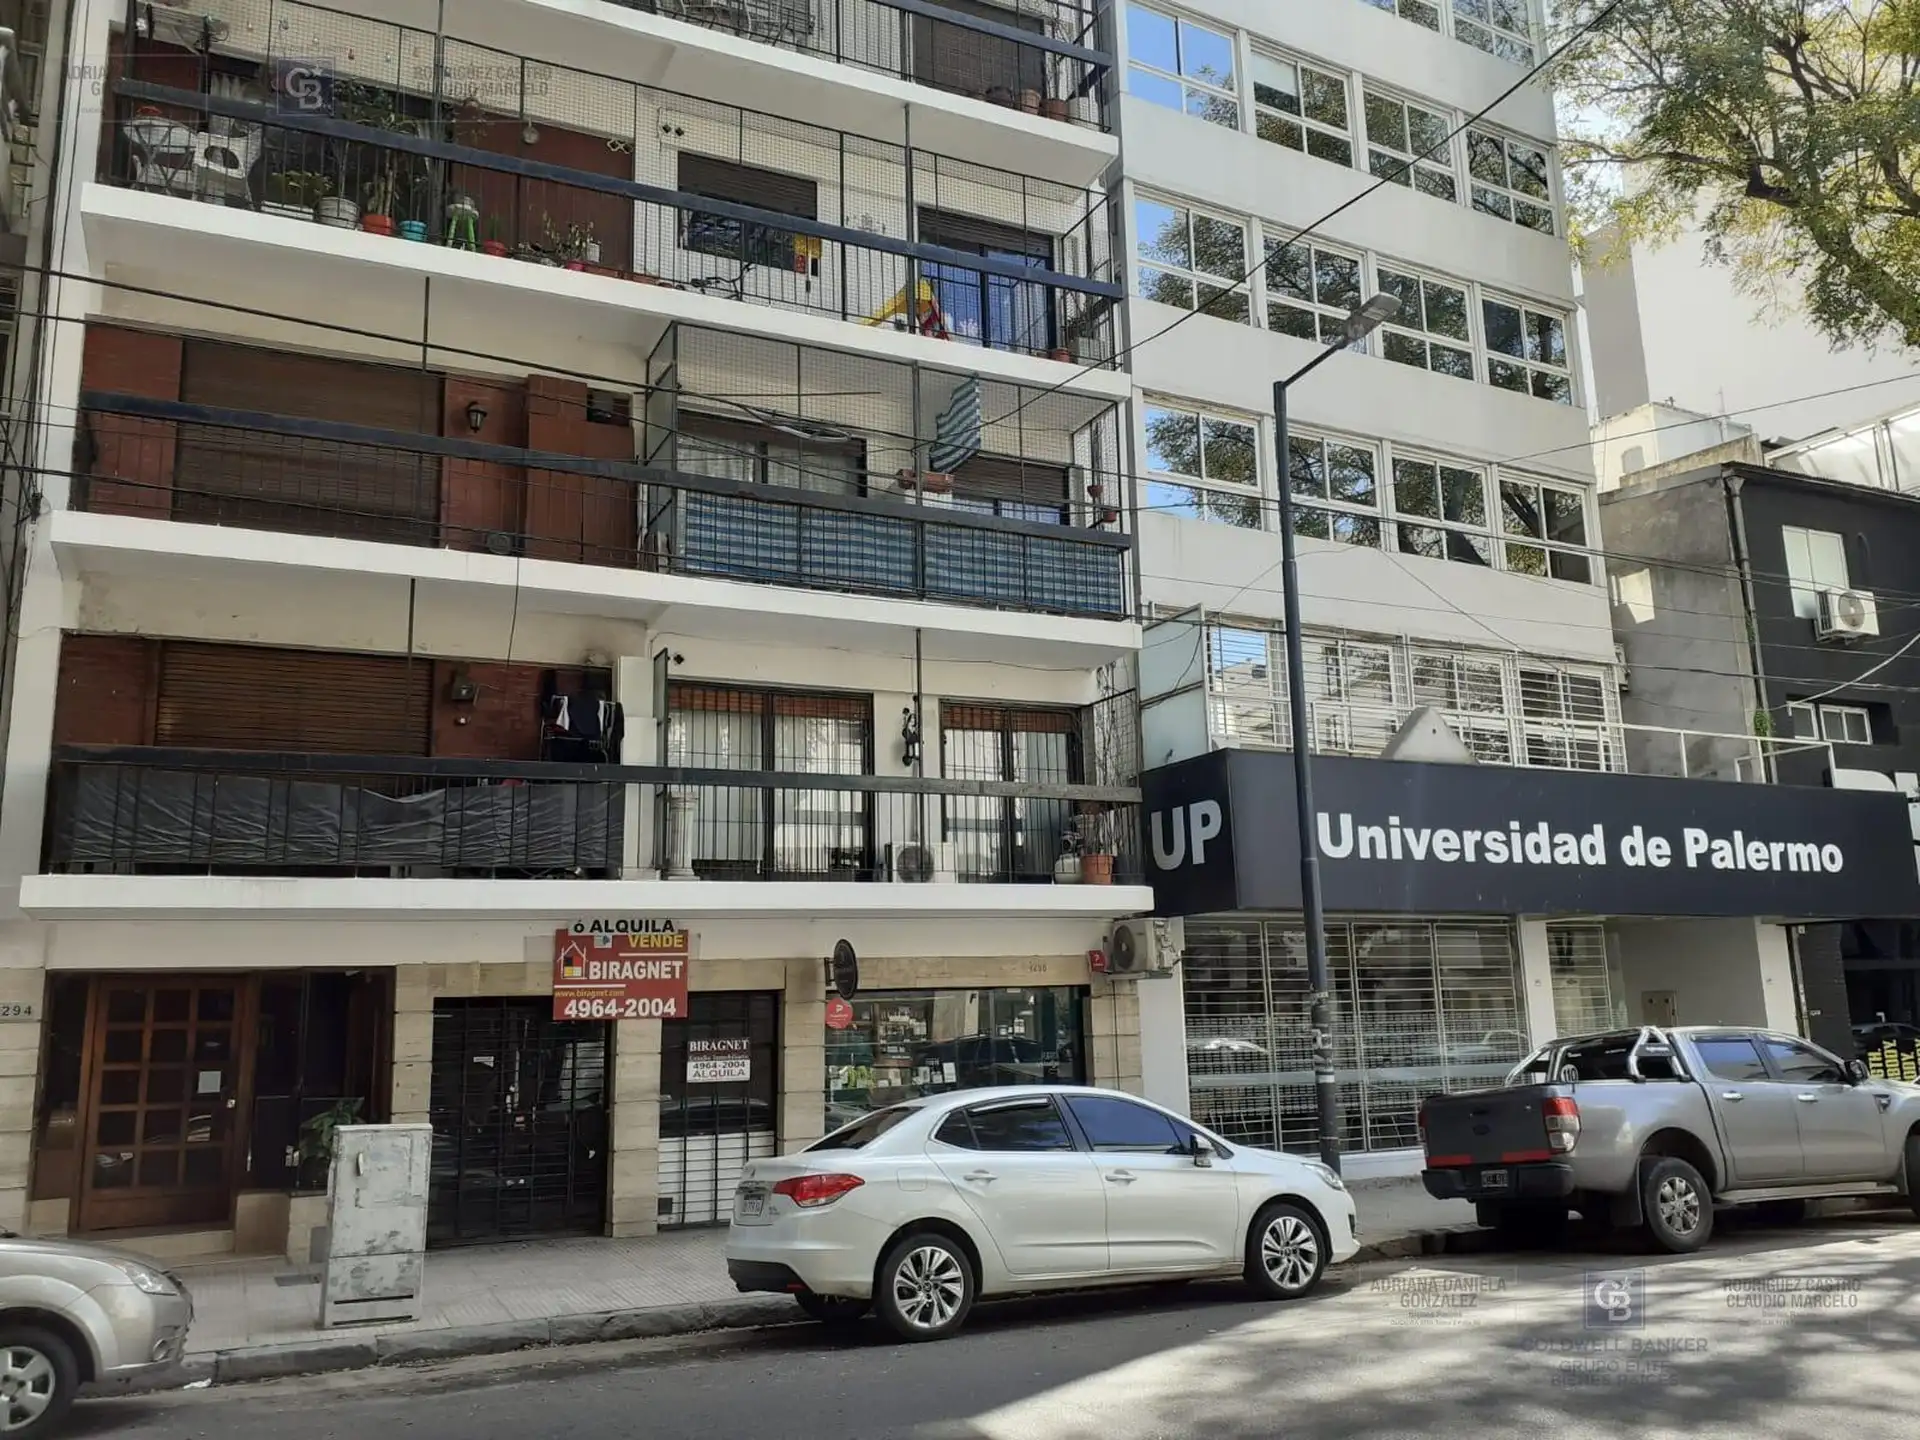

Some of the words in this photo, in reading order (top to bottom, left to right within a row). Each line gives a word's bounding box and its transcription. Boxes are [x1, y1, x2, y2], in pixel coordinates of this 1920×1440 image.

[1150, 799, 1222, 871] UP
[1316, 812, 1607, 866] Universidad
[1620, 825, 1671, 868] de
[1683, 827, 1843, 873] Palermo
[589, 918, 675, 934] ALQUILA
[627, 933, 684, 948] VENDE
[588, 960, 684, 980] BIRAGNET
[564, 997, 677, 1018] 4964-2004
[690, 1039, 749, 1052] BIRAGNET
[693, 1069, 746, 1079] ALQUILA
